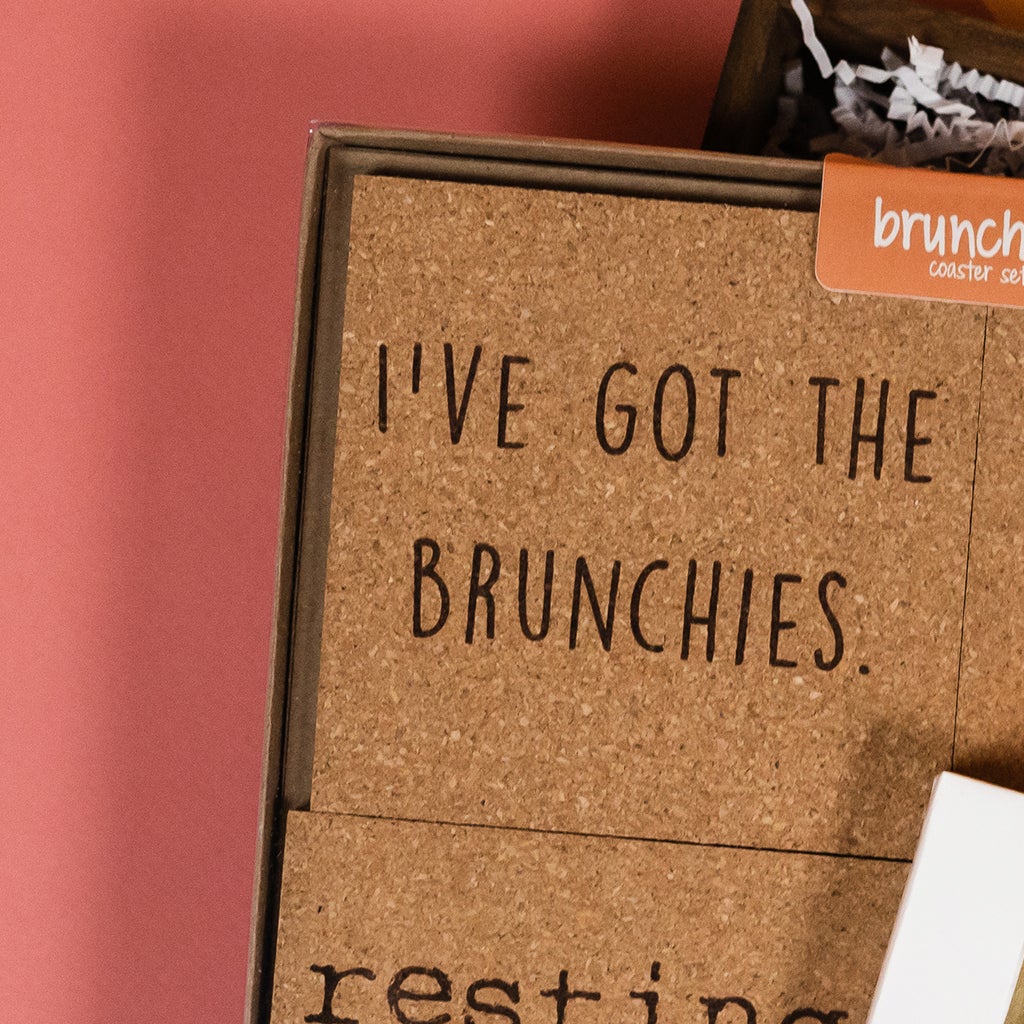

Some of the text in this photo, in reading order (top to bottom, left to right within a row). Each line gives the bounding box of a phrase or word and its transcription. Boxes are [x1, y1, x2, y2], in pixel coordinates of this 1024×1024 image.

[929, 259, 992, 282] coaster
[377, 342, 938, 483] I'VE GOT THE
[411, 537, 870, 675] BRUNCHIES.
